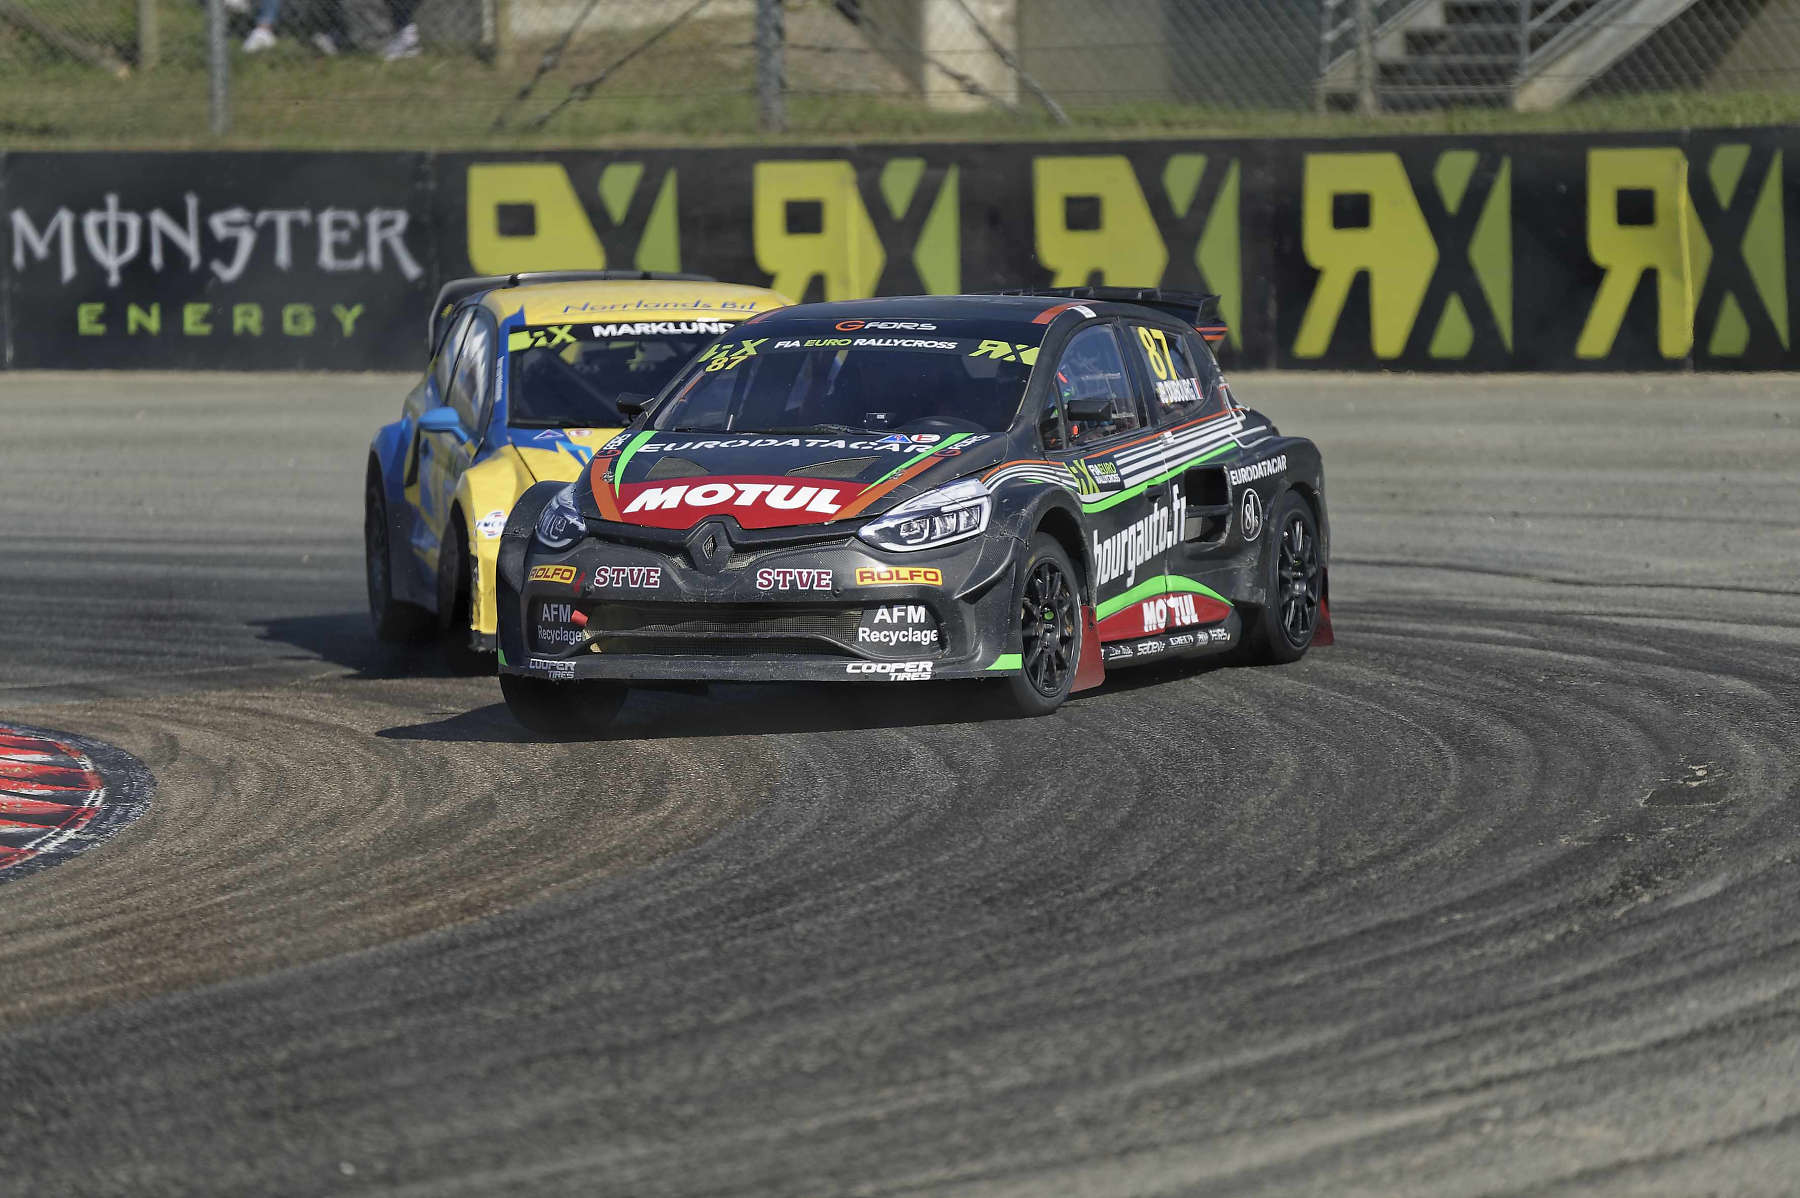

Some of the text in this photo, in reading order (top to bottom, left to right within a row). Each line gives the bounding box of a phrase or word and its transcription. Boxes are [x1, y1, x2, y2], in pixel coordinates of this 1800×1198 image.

[11, 191, 424, 288] MONSTER
[562, 299, 712, 314] Norrlands
[77, 302, 365, 338] ENERGY
[774, 337, 959, 350] FIA EURO RALLYCROSS
[1137, 326, 1178, 381] 87
[704, 355, 750, 373] 87
[636, 437, 934, 454] EURODATACAR
[1230, 454, 1288, 486] EURODATACAR
[622, 483, 842, 514] MOTUL
[1093, 483, 1187, 588] bourgauto.fr
[530, 567, 574, 581] ROLFO
[593, 565, 661, 589] STVE
[756, 567, 833, 591] STVE
[858, 569, 940, 583] ROLFO
[542, 603, 571, 623] AFM
[873, 605, 927, 624] AFM
[1142, 593, 1199, 633] MOTUL
[537, 624, 583, 646] Recyclage
[858, 626, 939, 646] Recyclage
[529, 658, 577, 672] COOPER
[547, 670, 576, 679] TIRES
[846, 661, 934, 674] COOPER
[888, 672, 932, 681] TIRES
